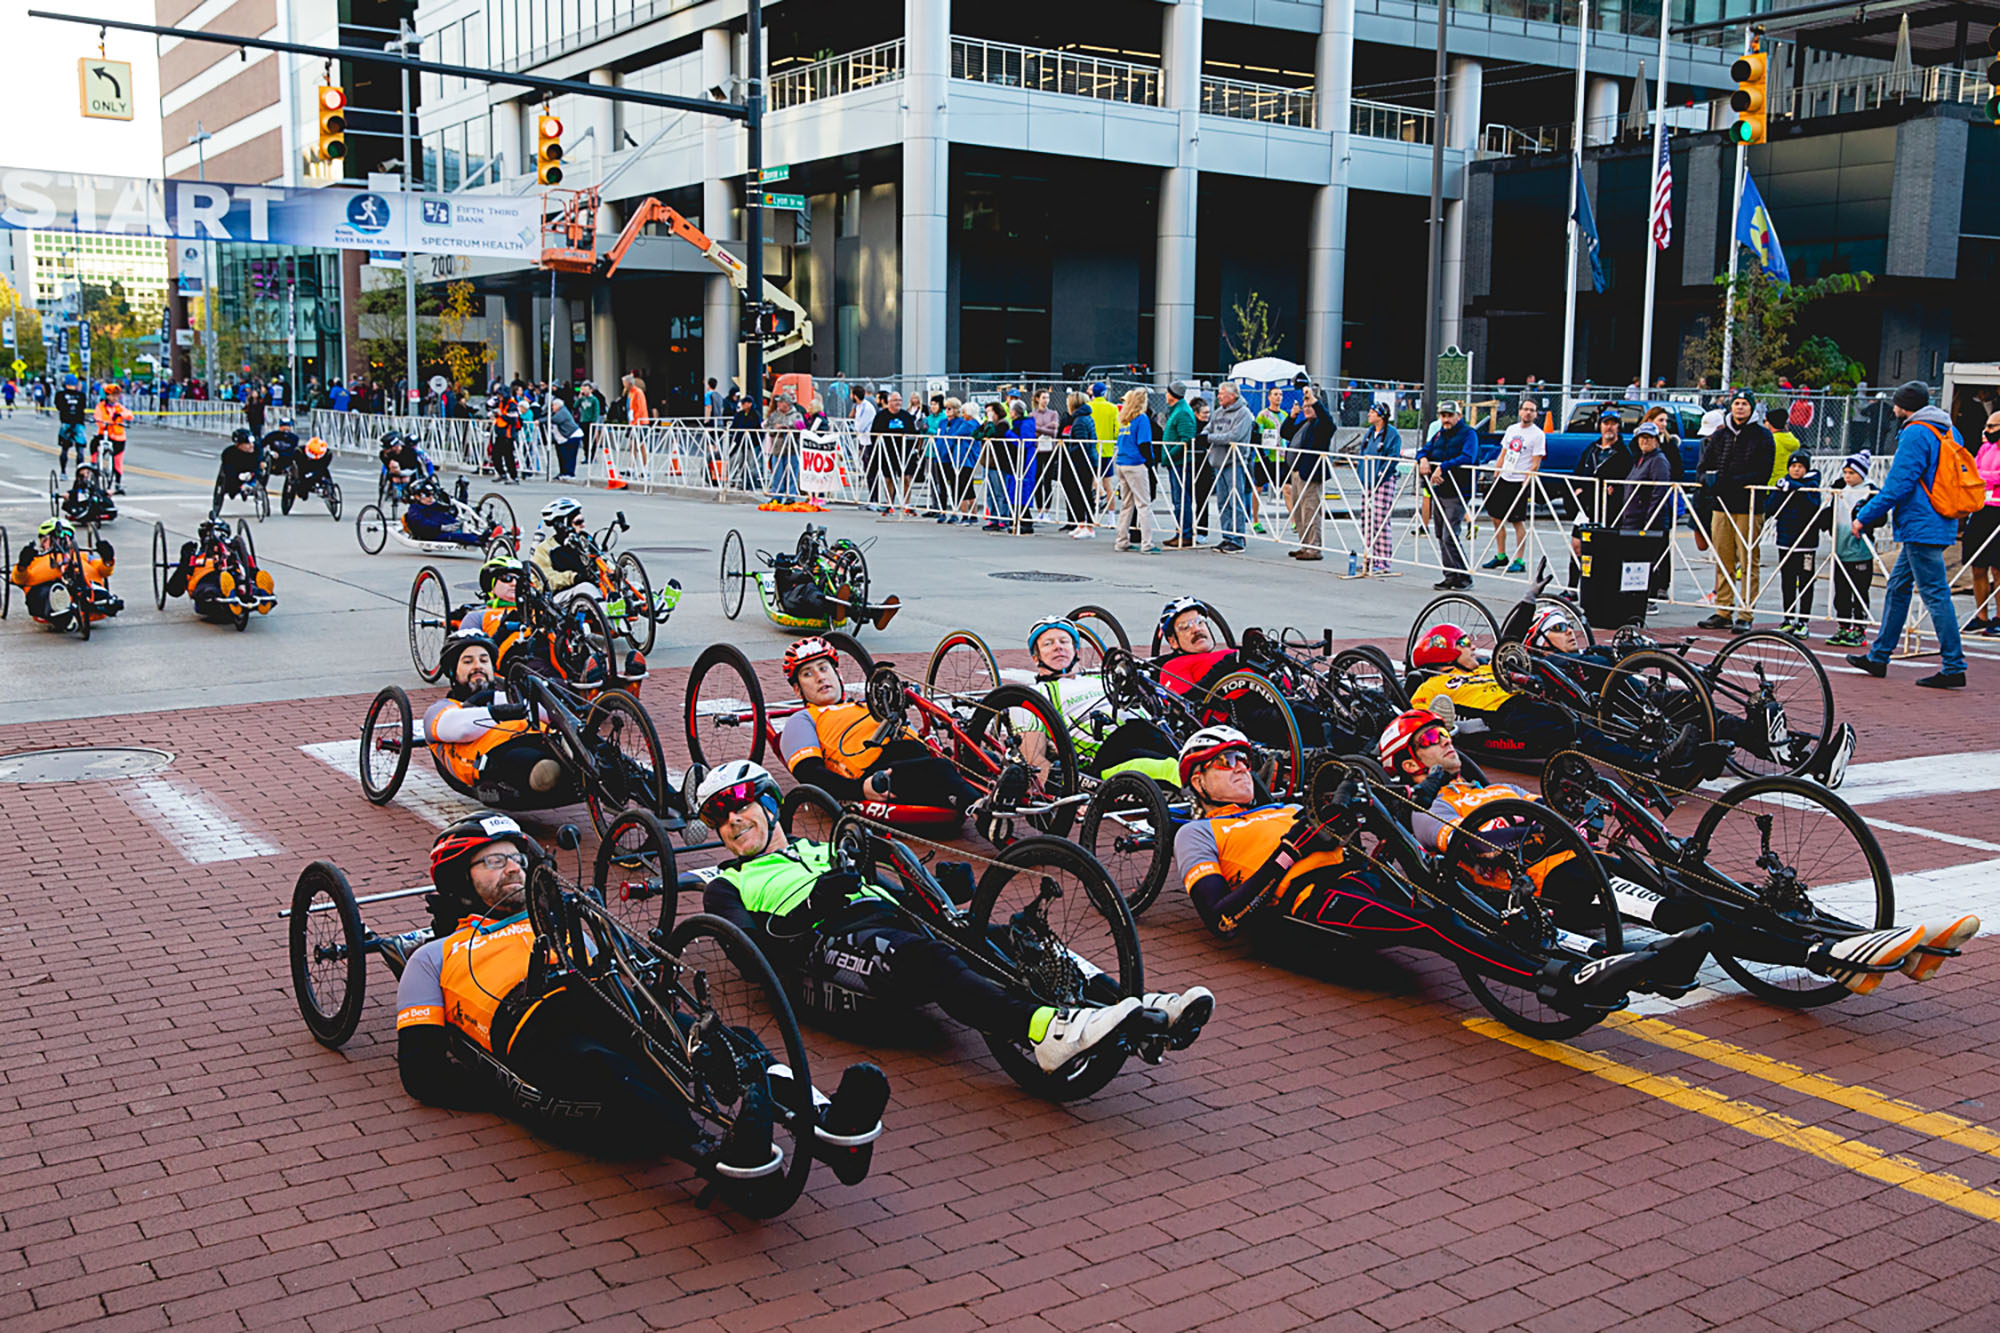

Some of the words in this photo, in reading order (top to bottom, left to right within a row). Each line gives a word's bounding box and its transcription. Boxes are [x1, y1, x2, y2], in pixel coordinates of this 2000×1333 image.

[92, 100, 127, 113] ONLY
[0, 170, 285, 242] START
[421, 237, 481, 250] SPECTRUM
[483, 239, 525, 252] HEALTH
[1222, 680, 1246, 693] TOP
[1248, 682, 1274, 704] END
[866, 802, 897, 819] RX
[410, 1007, 430, 1018] Bed
